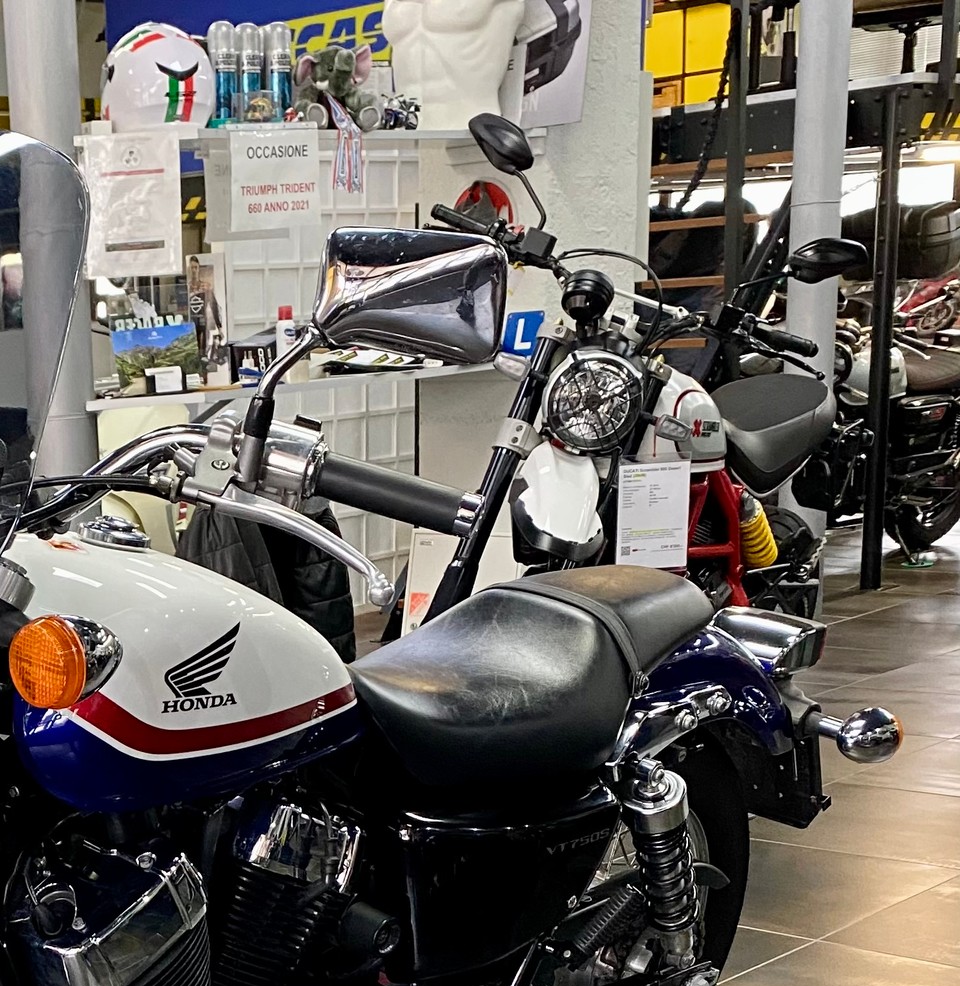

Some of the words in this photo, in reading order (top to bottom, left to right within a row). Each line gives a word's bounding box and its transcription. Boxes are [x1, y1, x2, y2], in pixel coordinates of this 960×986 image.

[246, 144, 309, 159] OCCASIONE
[240, 184, 278, 196] TRIUMPH
[280, 182, 316, 194] TRIDENT
[248, 203, 262, 214] 660
[264, 201, 289, 212] ANNO
[291, 200, 309, 211] 2021
[513, 318, 532, 351] L
[161, 692, 238, 714] HONDA
[546, 828, 610, 855] VT750S
